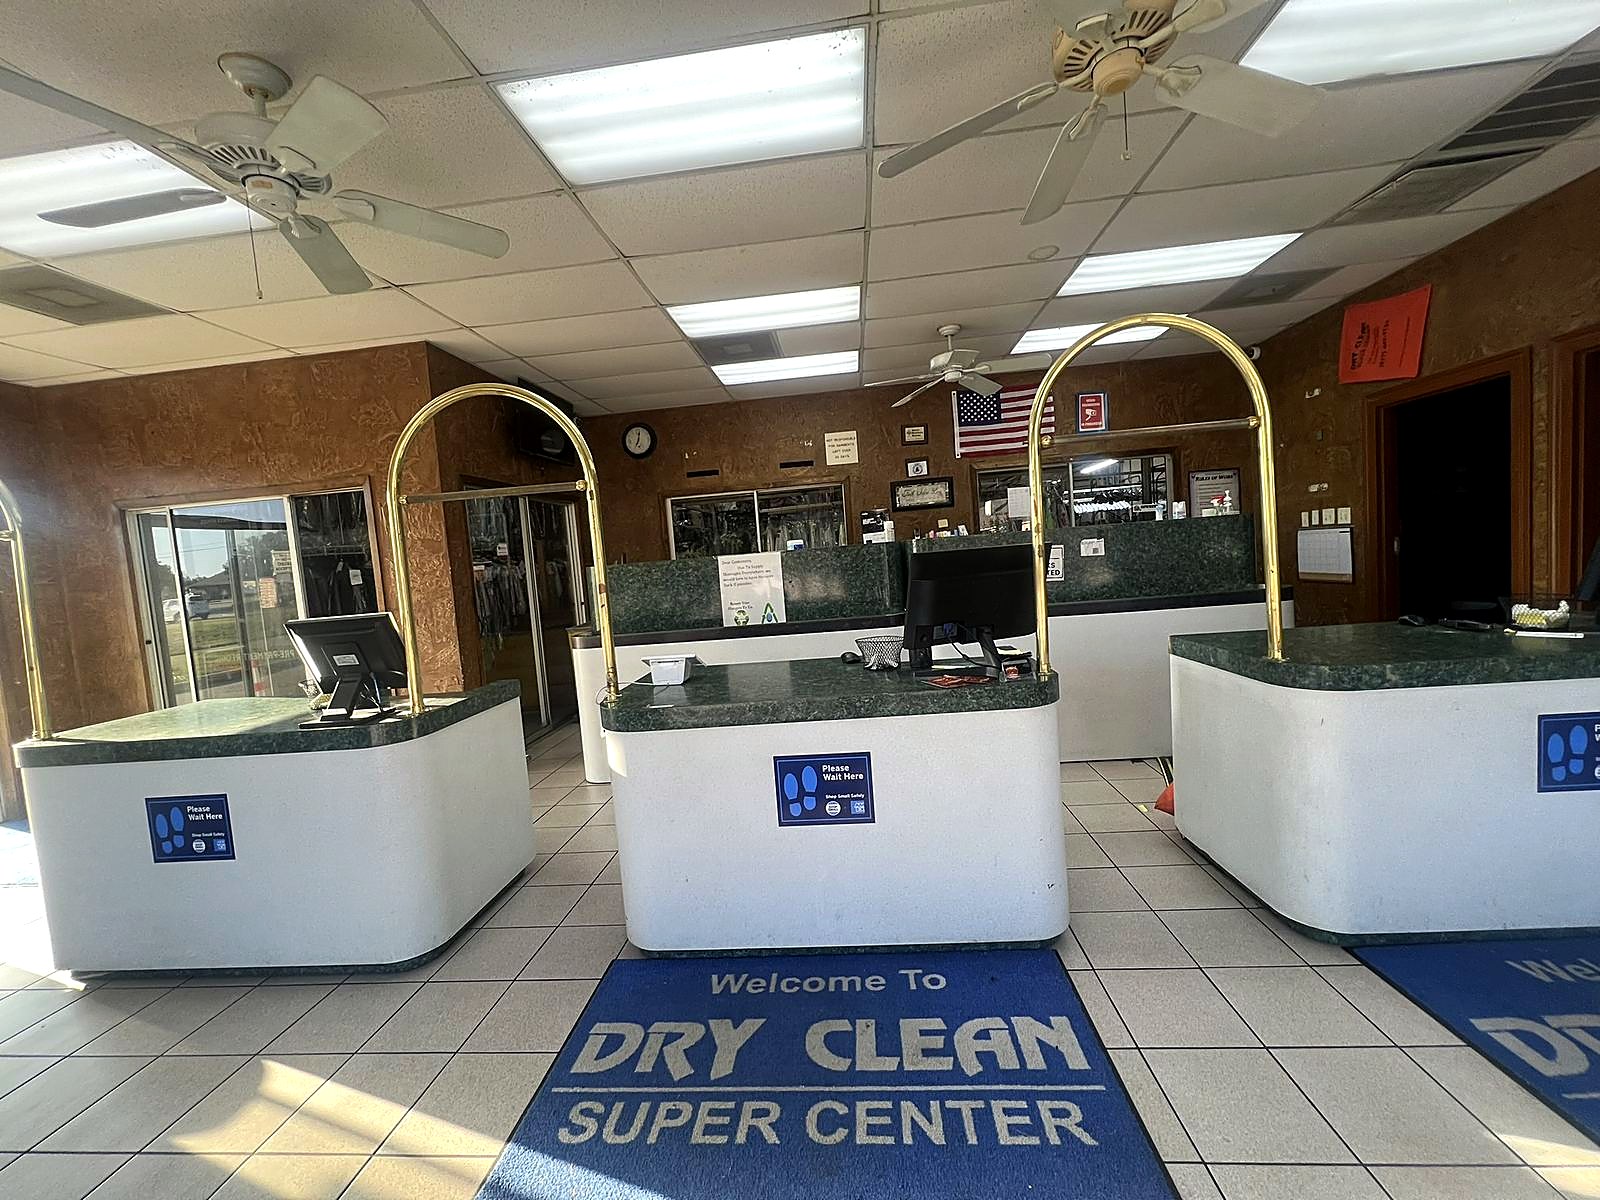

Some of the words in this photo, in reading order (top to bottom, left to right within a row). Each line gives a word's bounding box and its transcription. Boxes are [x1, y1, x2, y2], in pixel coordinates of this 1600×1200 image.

[822, 764, 850, 772] Please
[844, 772, 864, 780] Here
[710, 973, 887, 994] Welcome
[898, 969, 947, 990] To
[570, 1018, 768, 1081] DRY
[805, 1016, 1091, 1077] CLEAN
[557, 1100, 780, 1145] SUPER
[805, 1100, 1098, 1145] CENTER
